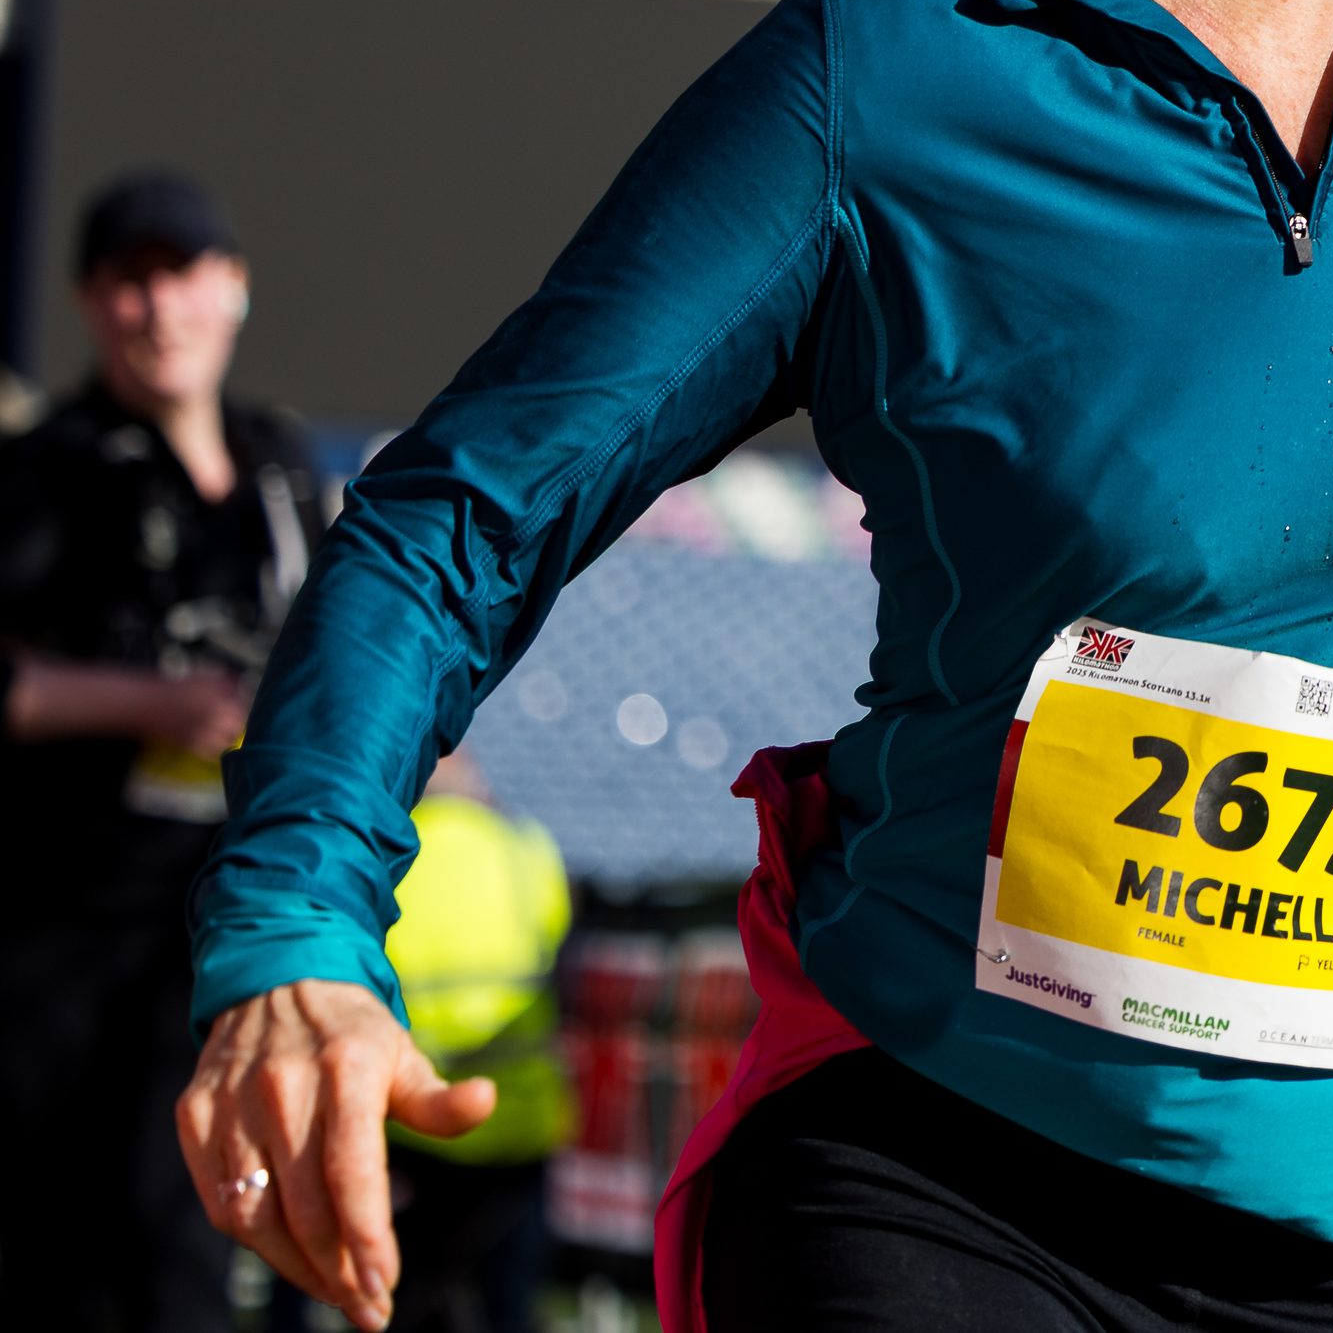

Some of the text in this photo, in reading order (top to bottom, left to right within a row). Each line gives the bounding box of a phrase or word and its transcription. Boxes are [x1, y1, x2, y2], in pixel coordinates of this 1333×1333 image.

[1066, 666, 1087, 676] 2025
[1137, 927, 1185, 948] FEMALE
[1005, 966, 1093, 1008] JustGiving
[1122, 997, 1230, 1031] MACMILLAN
[1122, 1012, 1221, 1041] CANCER SUPPORT
[1259, 1029, 1308, 1044] OCEAN
